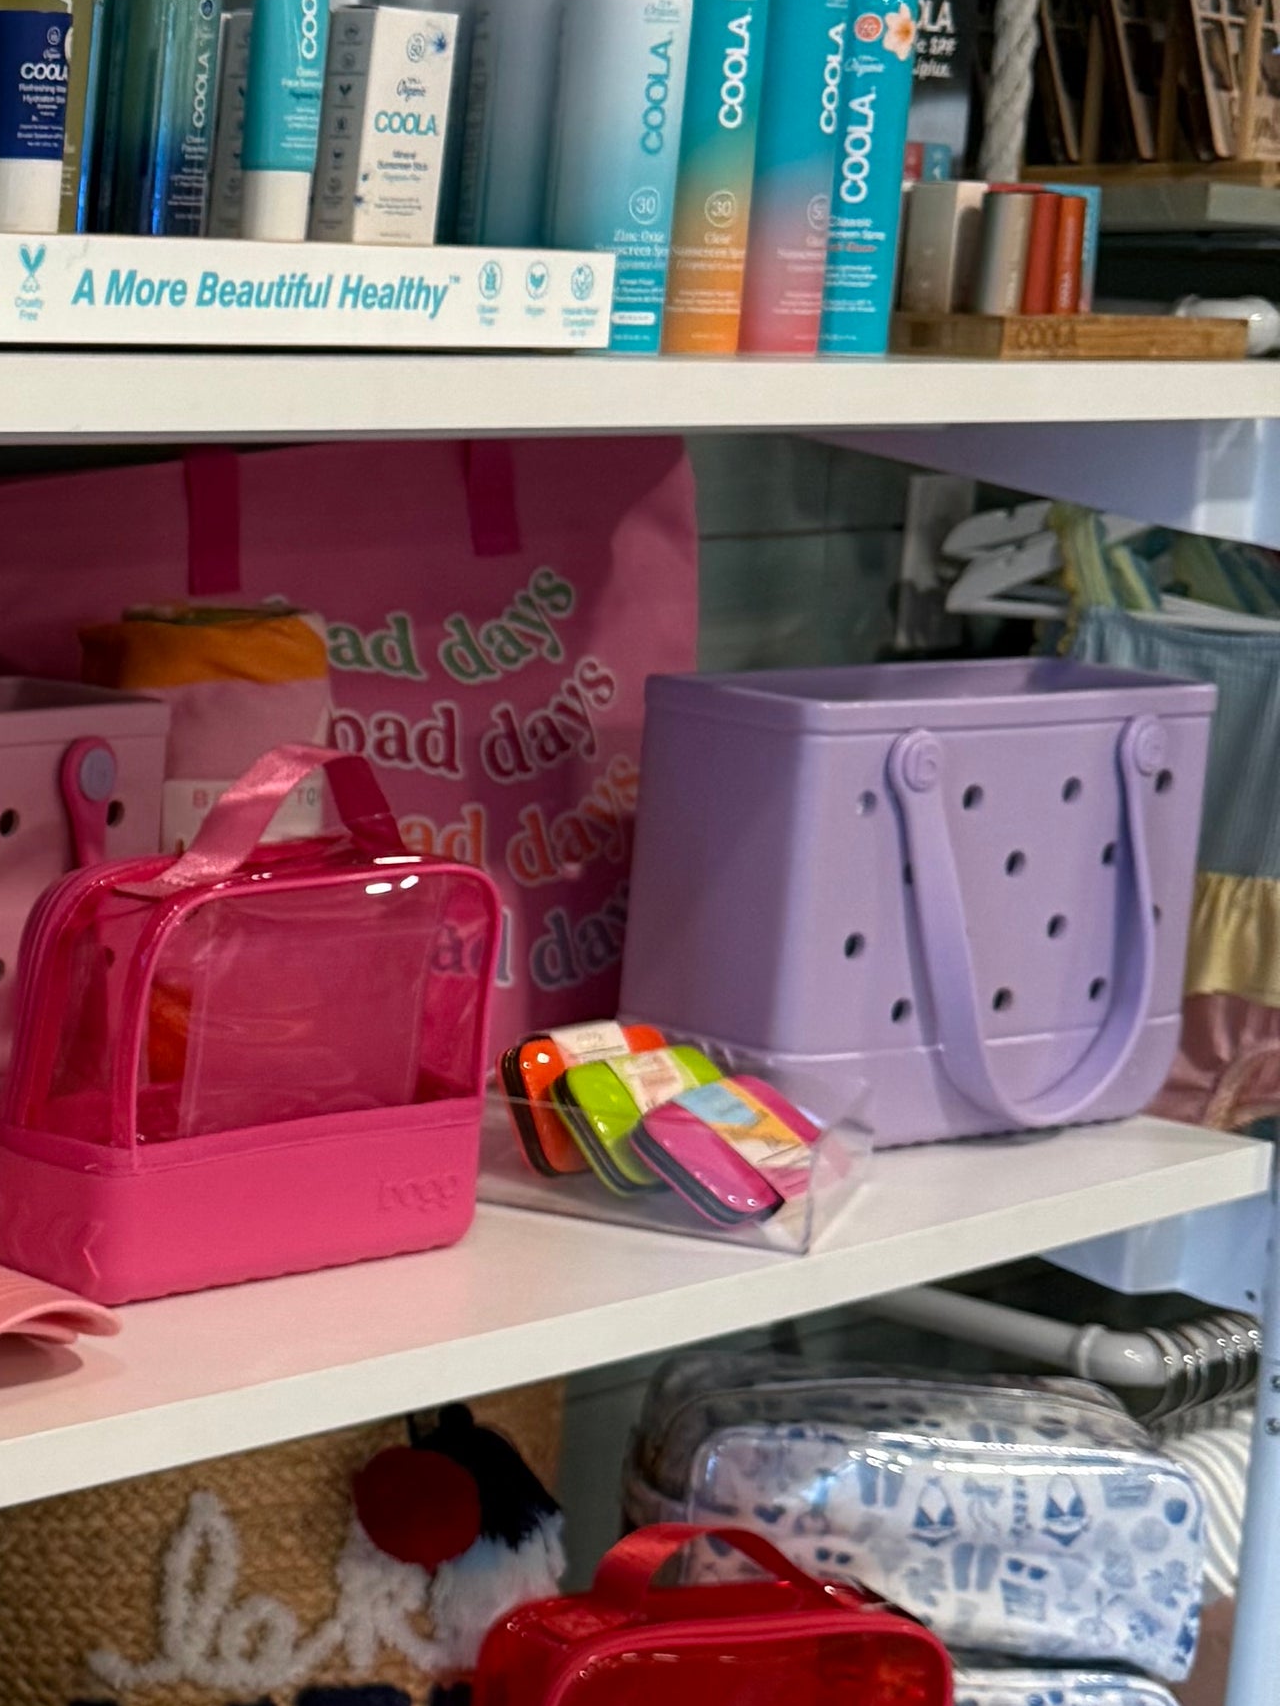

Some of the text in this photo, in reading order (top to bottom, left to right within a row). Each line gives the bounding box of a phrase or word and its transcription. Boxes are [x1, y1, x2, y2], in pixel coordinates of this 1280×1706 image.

[192, 53, 210, 129] COOLA
[642, 38, 674, 156] COOLA
[718, 13, 753, 130] COOLA
[820, 21, 847, 134] COOLA
[374, 110, 438, 137] COOLA
[840, 90, 878, 205] COOLA
[635, 197, 656, 215] 30
[710, 200, 732, 218] 30
[71, 268, 96, 306] A
[104, 270, 187, 308] More
[197, 269, 334, 311] Beautiful
[328, 563, 577, 685] ad days
[479, 654, 618, 783] days
[400, 801, 488, 873] ad
